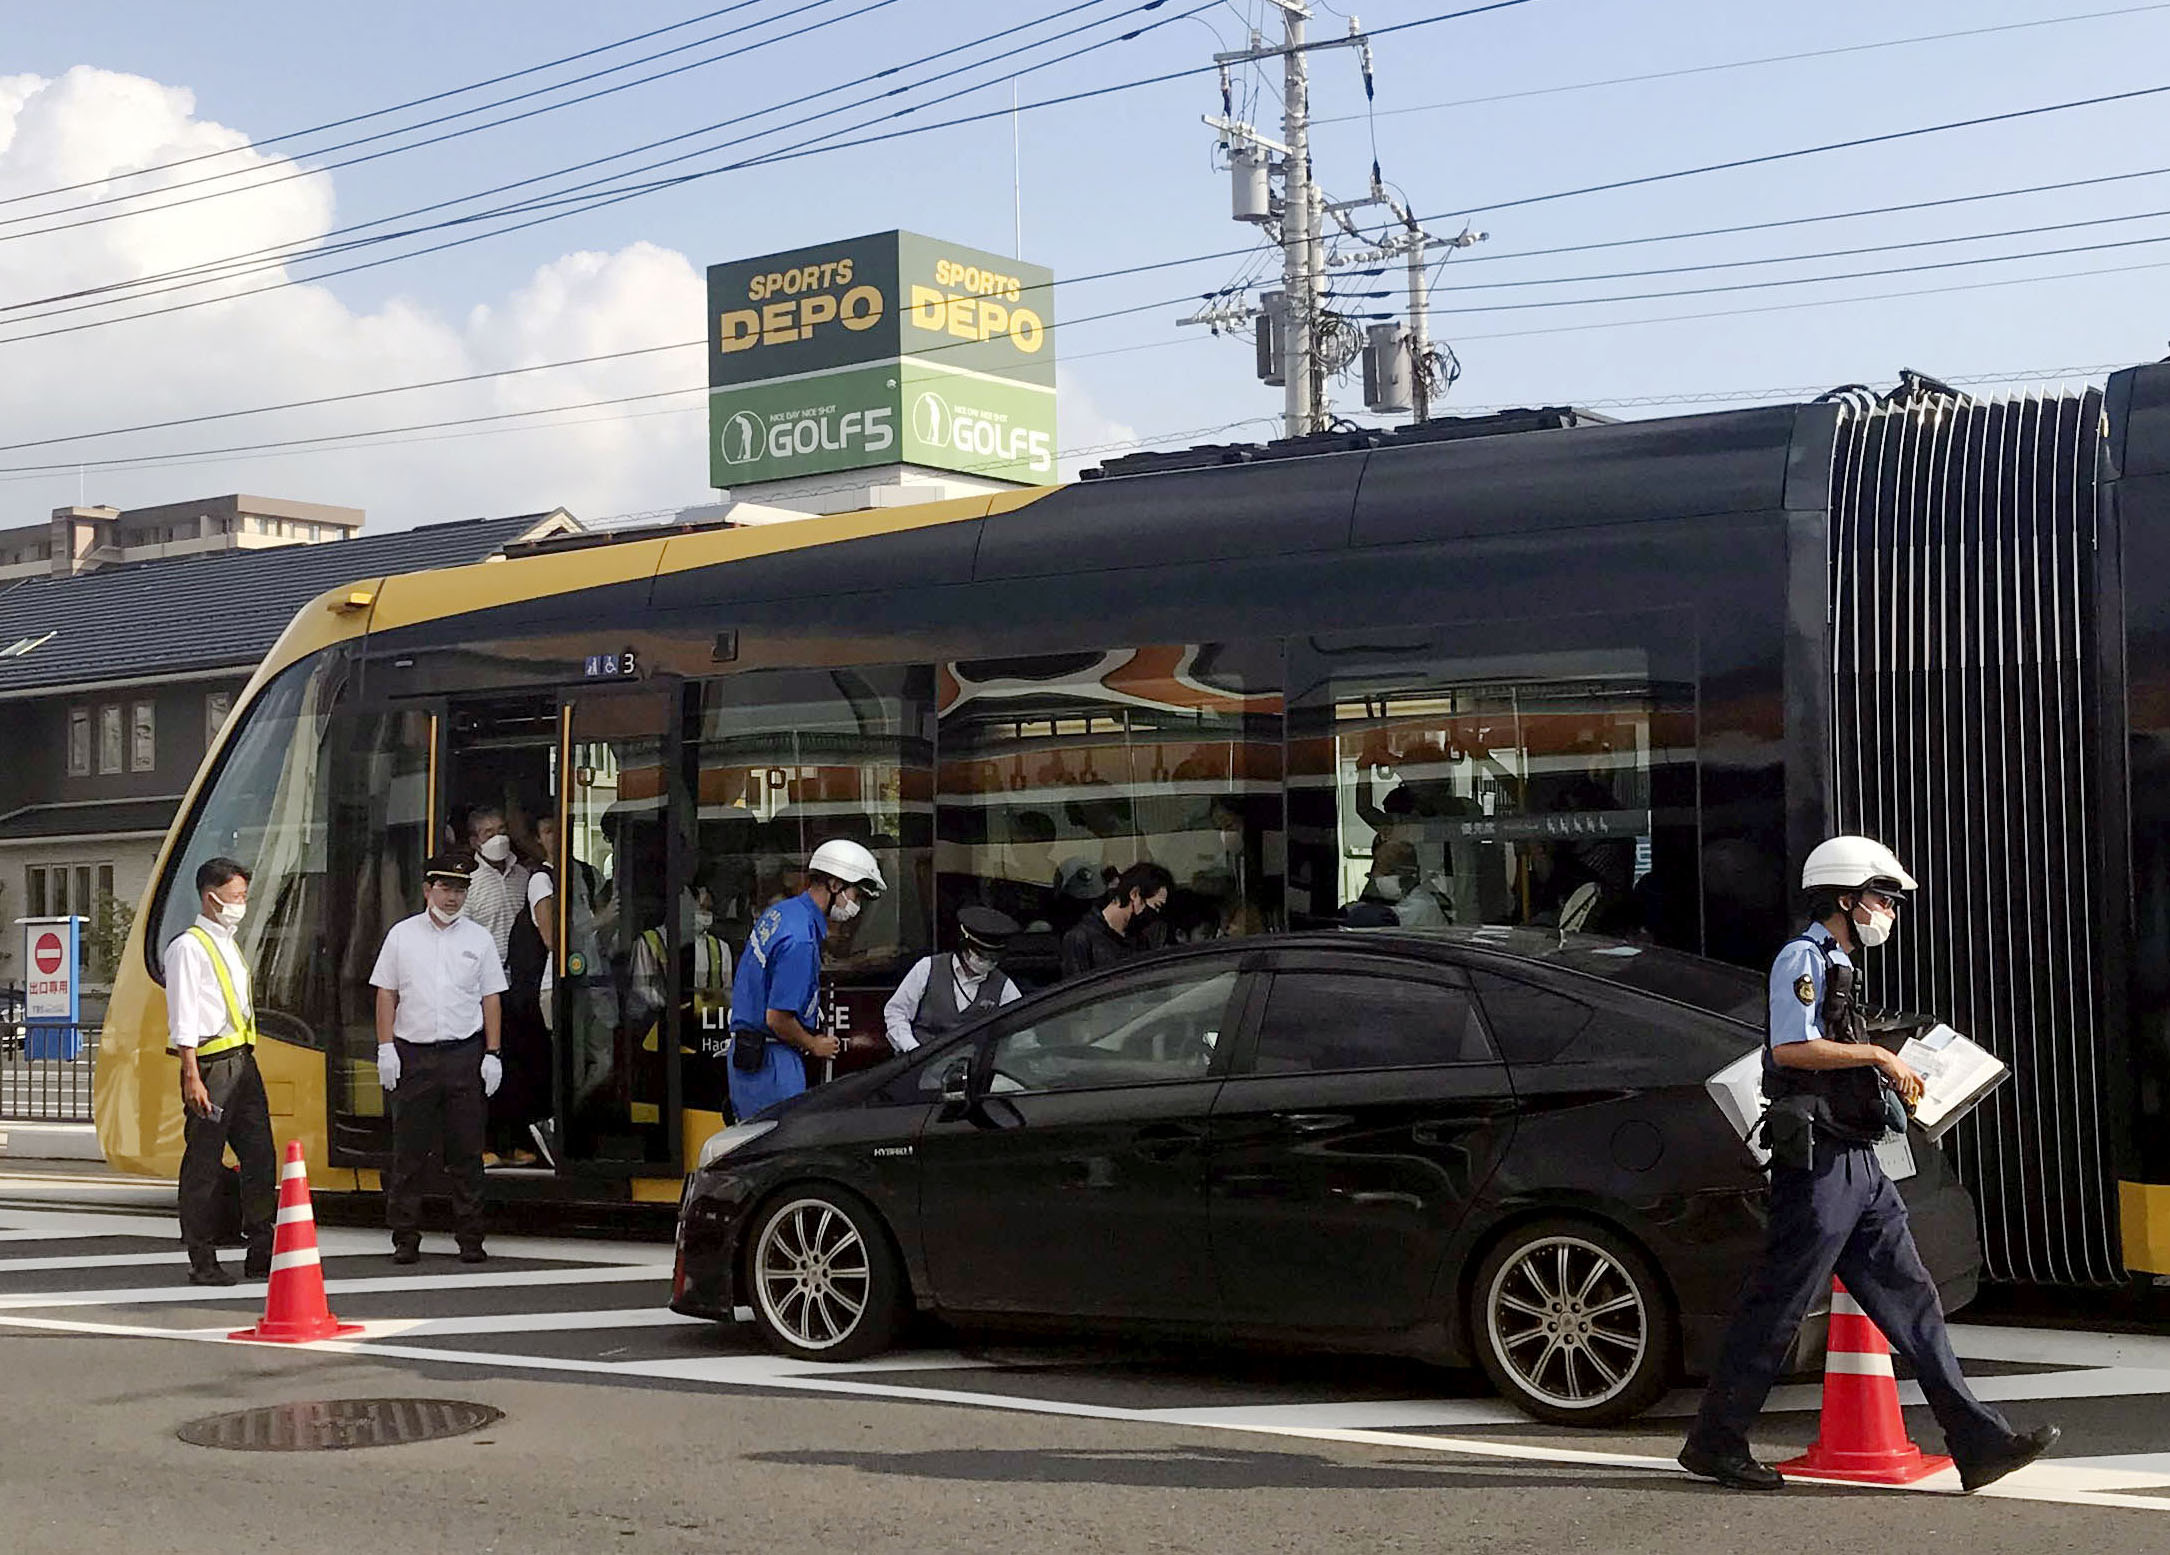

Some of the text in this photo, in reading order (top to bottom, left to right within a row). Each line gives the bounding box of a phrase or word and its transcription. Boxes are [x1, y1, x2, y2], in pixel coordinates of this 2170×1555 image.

[748, 258, 854, 301] SPORTS
[936, 259, 1021, 303] SPORTS
[721, 285, 883, 354] DEPO
[912, 285, 1044, 353] DEPO
[768, 407, 894, 458] GOLF5
[769, 412, 786, 422] NICE
[801, 407, 818, 418] NICE
[818, 404, 837, 415] SHOT
[953, 417, 1051, 472] GOLF5
[623, 653, 635, 674] 3
